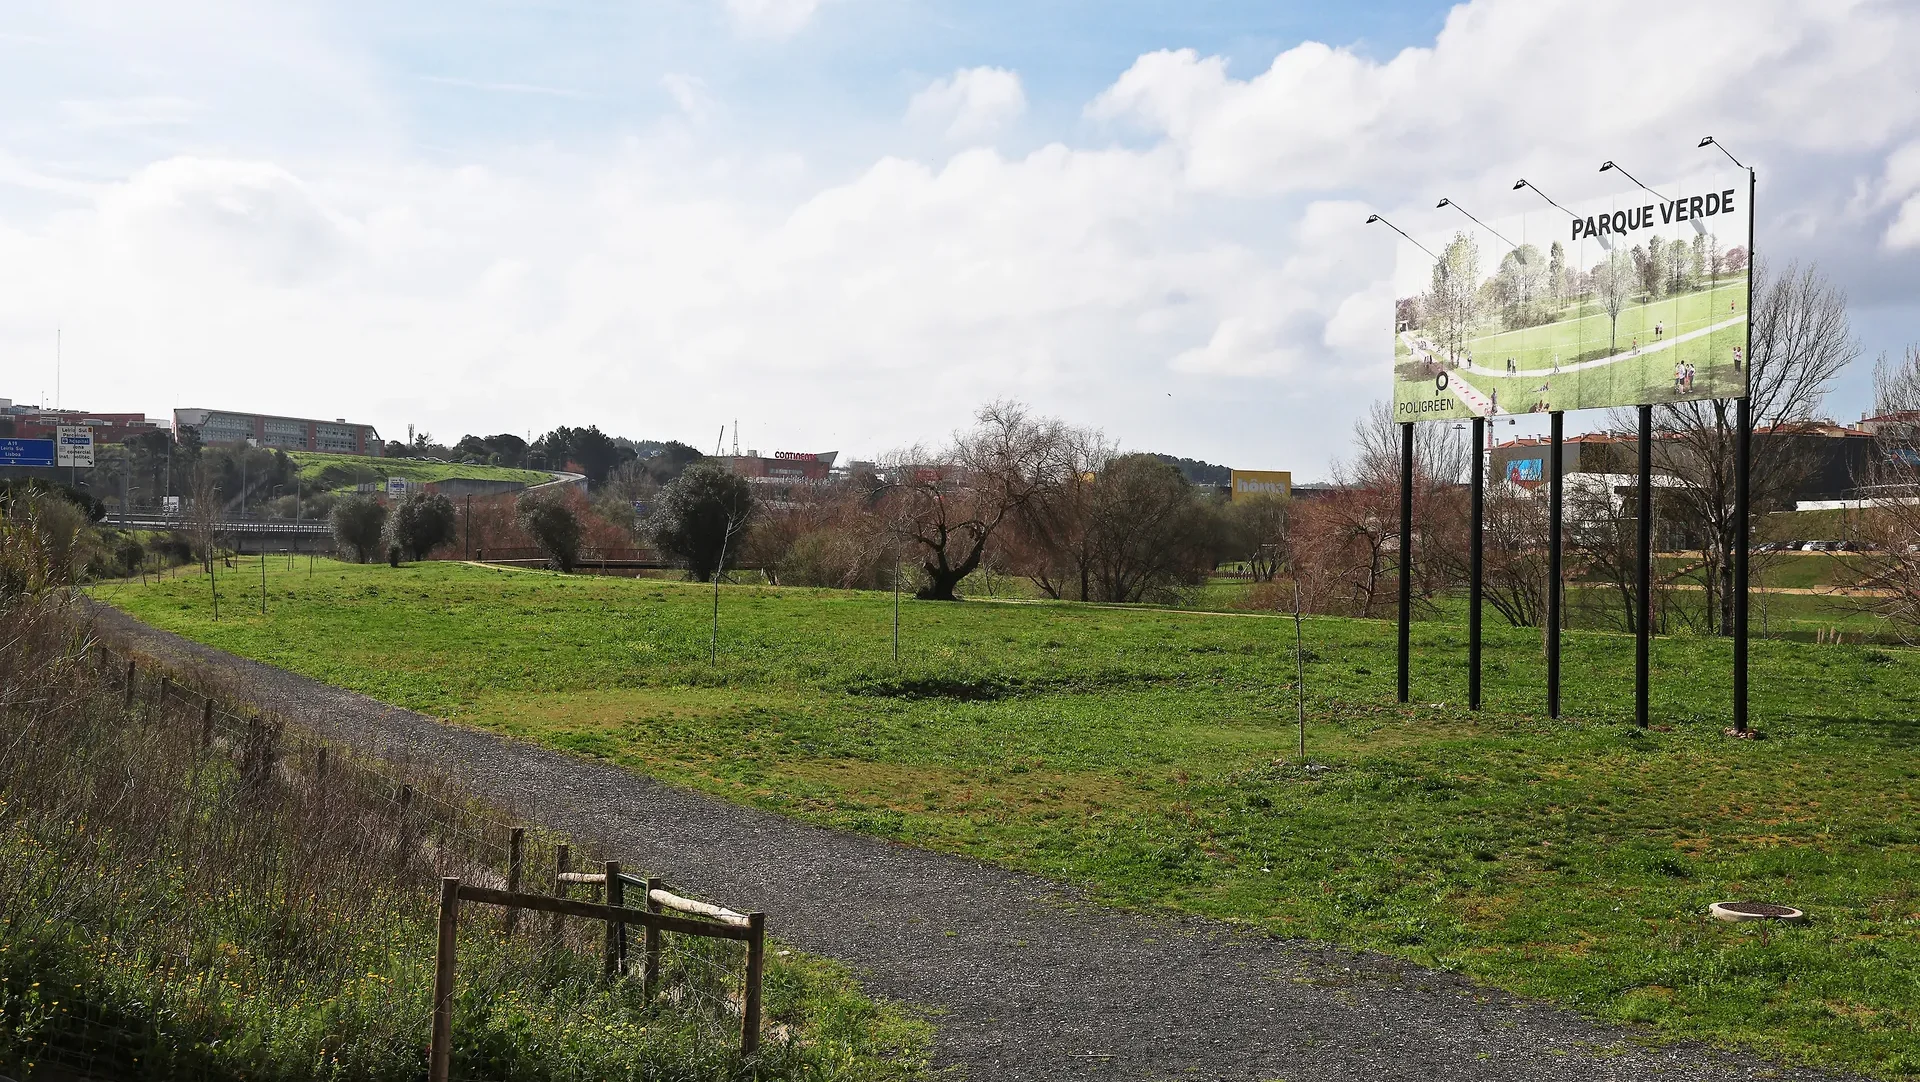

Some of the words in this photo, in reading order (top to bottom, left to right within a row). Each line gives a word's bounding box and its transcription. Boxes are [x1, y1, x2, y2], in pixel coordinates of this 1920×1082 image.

[1572, 204, 1655, 241] PARQUE
[1659, 188, 1735, 225] VERDE
[1399, 398, 1454, 414] POLIGREEN
